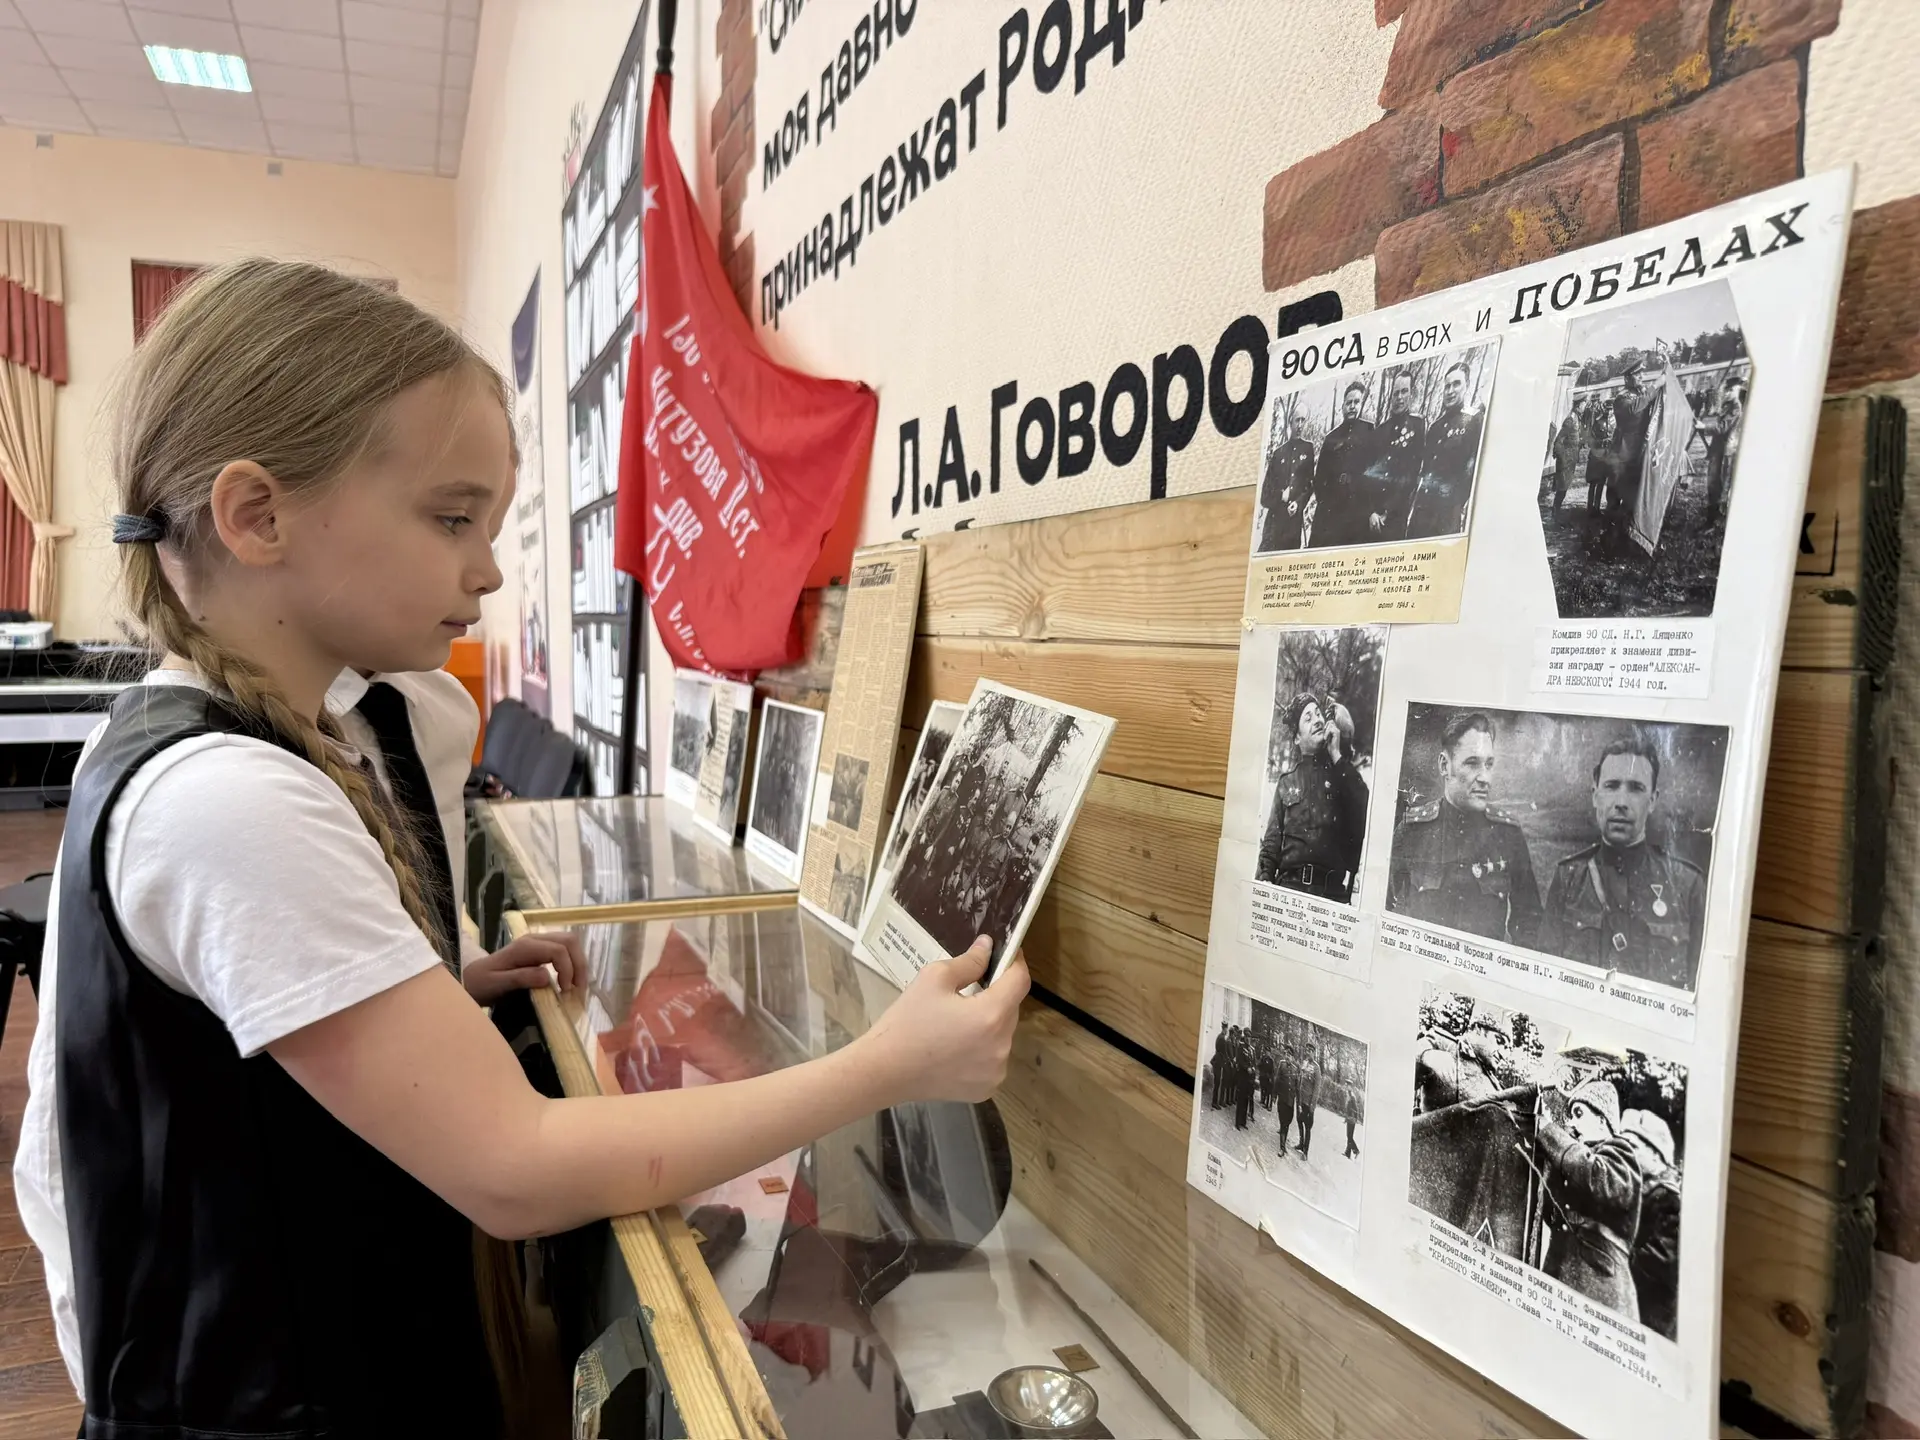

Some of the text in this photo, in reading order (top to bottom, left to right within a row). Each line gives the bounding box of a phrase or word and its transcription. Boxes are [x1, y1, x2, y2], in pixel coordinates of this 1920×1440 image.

[763, 0, 918, 192] моя давно
[762, 0, 1167, 331] принадлежат РОД
[1280, 347, 1319, 381] 90
[1323, 332, 1366, 371] СД
[1396, 321, 1453, 356] БОЯХ
[1509, 203, 1811, 325] ПОБЕДАХ
[1276, 573, 1298, 582] ПЕРИОД
[1303, 571, 1329, 580] ПРОРЫВА
[1335, 568, 1365, 578] БЛОКАДЫ
[1371, 564, 1418, 575] ЛЕНИНГРАДА
[1288, 562, 1316, 572] ВОЕННОГО
[1321, 560, 1345, 569] СОВЕТА
[1375, 552, 1405, 565] УДАРНОЙ
[1412, 552, 1437, 562] АРМИИ
[1383, 585, 1412, 594] КОКОРЕВ
[1551, 629, 1694, 642] Комдив 90 СД. Н.Г. Лященко
[1548, 661, 1564, 670] зии
[1567, 661, 1604, 672] награду
[1550, 646, 1697, 658] прикрепляет к знамени диви-
[1546, 674, 1562, 687] ДРА
[1646, 679, 1667, 691] год.
[1380, 935, 1396, 947] гады
[1398, 941, 1412, 952] под
[1414, 945, 1450, 964] Синявино.
[1381, 920, 1409, 936] Комбриг
[1411, 929, 1421, 940] 73
[1423, 933, 1461, 952] Отдельной
[1463, 944, 1494, 962] Морской
[1496, 955, 1530, 972] бригады
[1533, 964, 1553, 979] Н.Г.
[1557, 971, 1595, 991] Лященко
[1609, 987, 1665, 1011] замполитом
[1669, 1003, 1695, 1017] бри-
[1429, 1219, 1469, 1248] Командарм
[1490, 1251, 1524, 1277] Ударной
[1527, 1273, 1553, 1294] армии
[1429, 1233, 1477, 1266] прикрепляет
[1489, 1268, 1523, 1293] знамени
[1527, 1287, 1538, 1301] 90
[1561, 1308, 1600, 1336] награду
[1616, 1339, 1646, 1362] орден
[1515, 1297, 1542, 1319] Слева
[1555, 1318, 1577, 1339] Н.Г.
